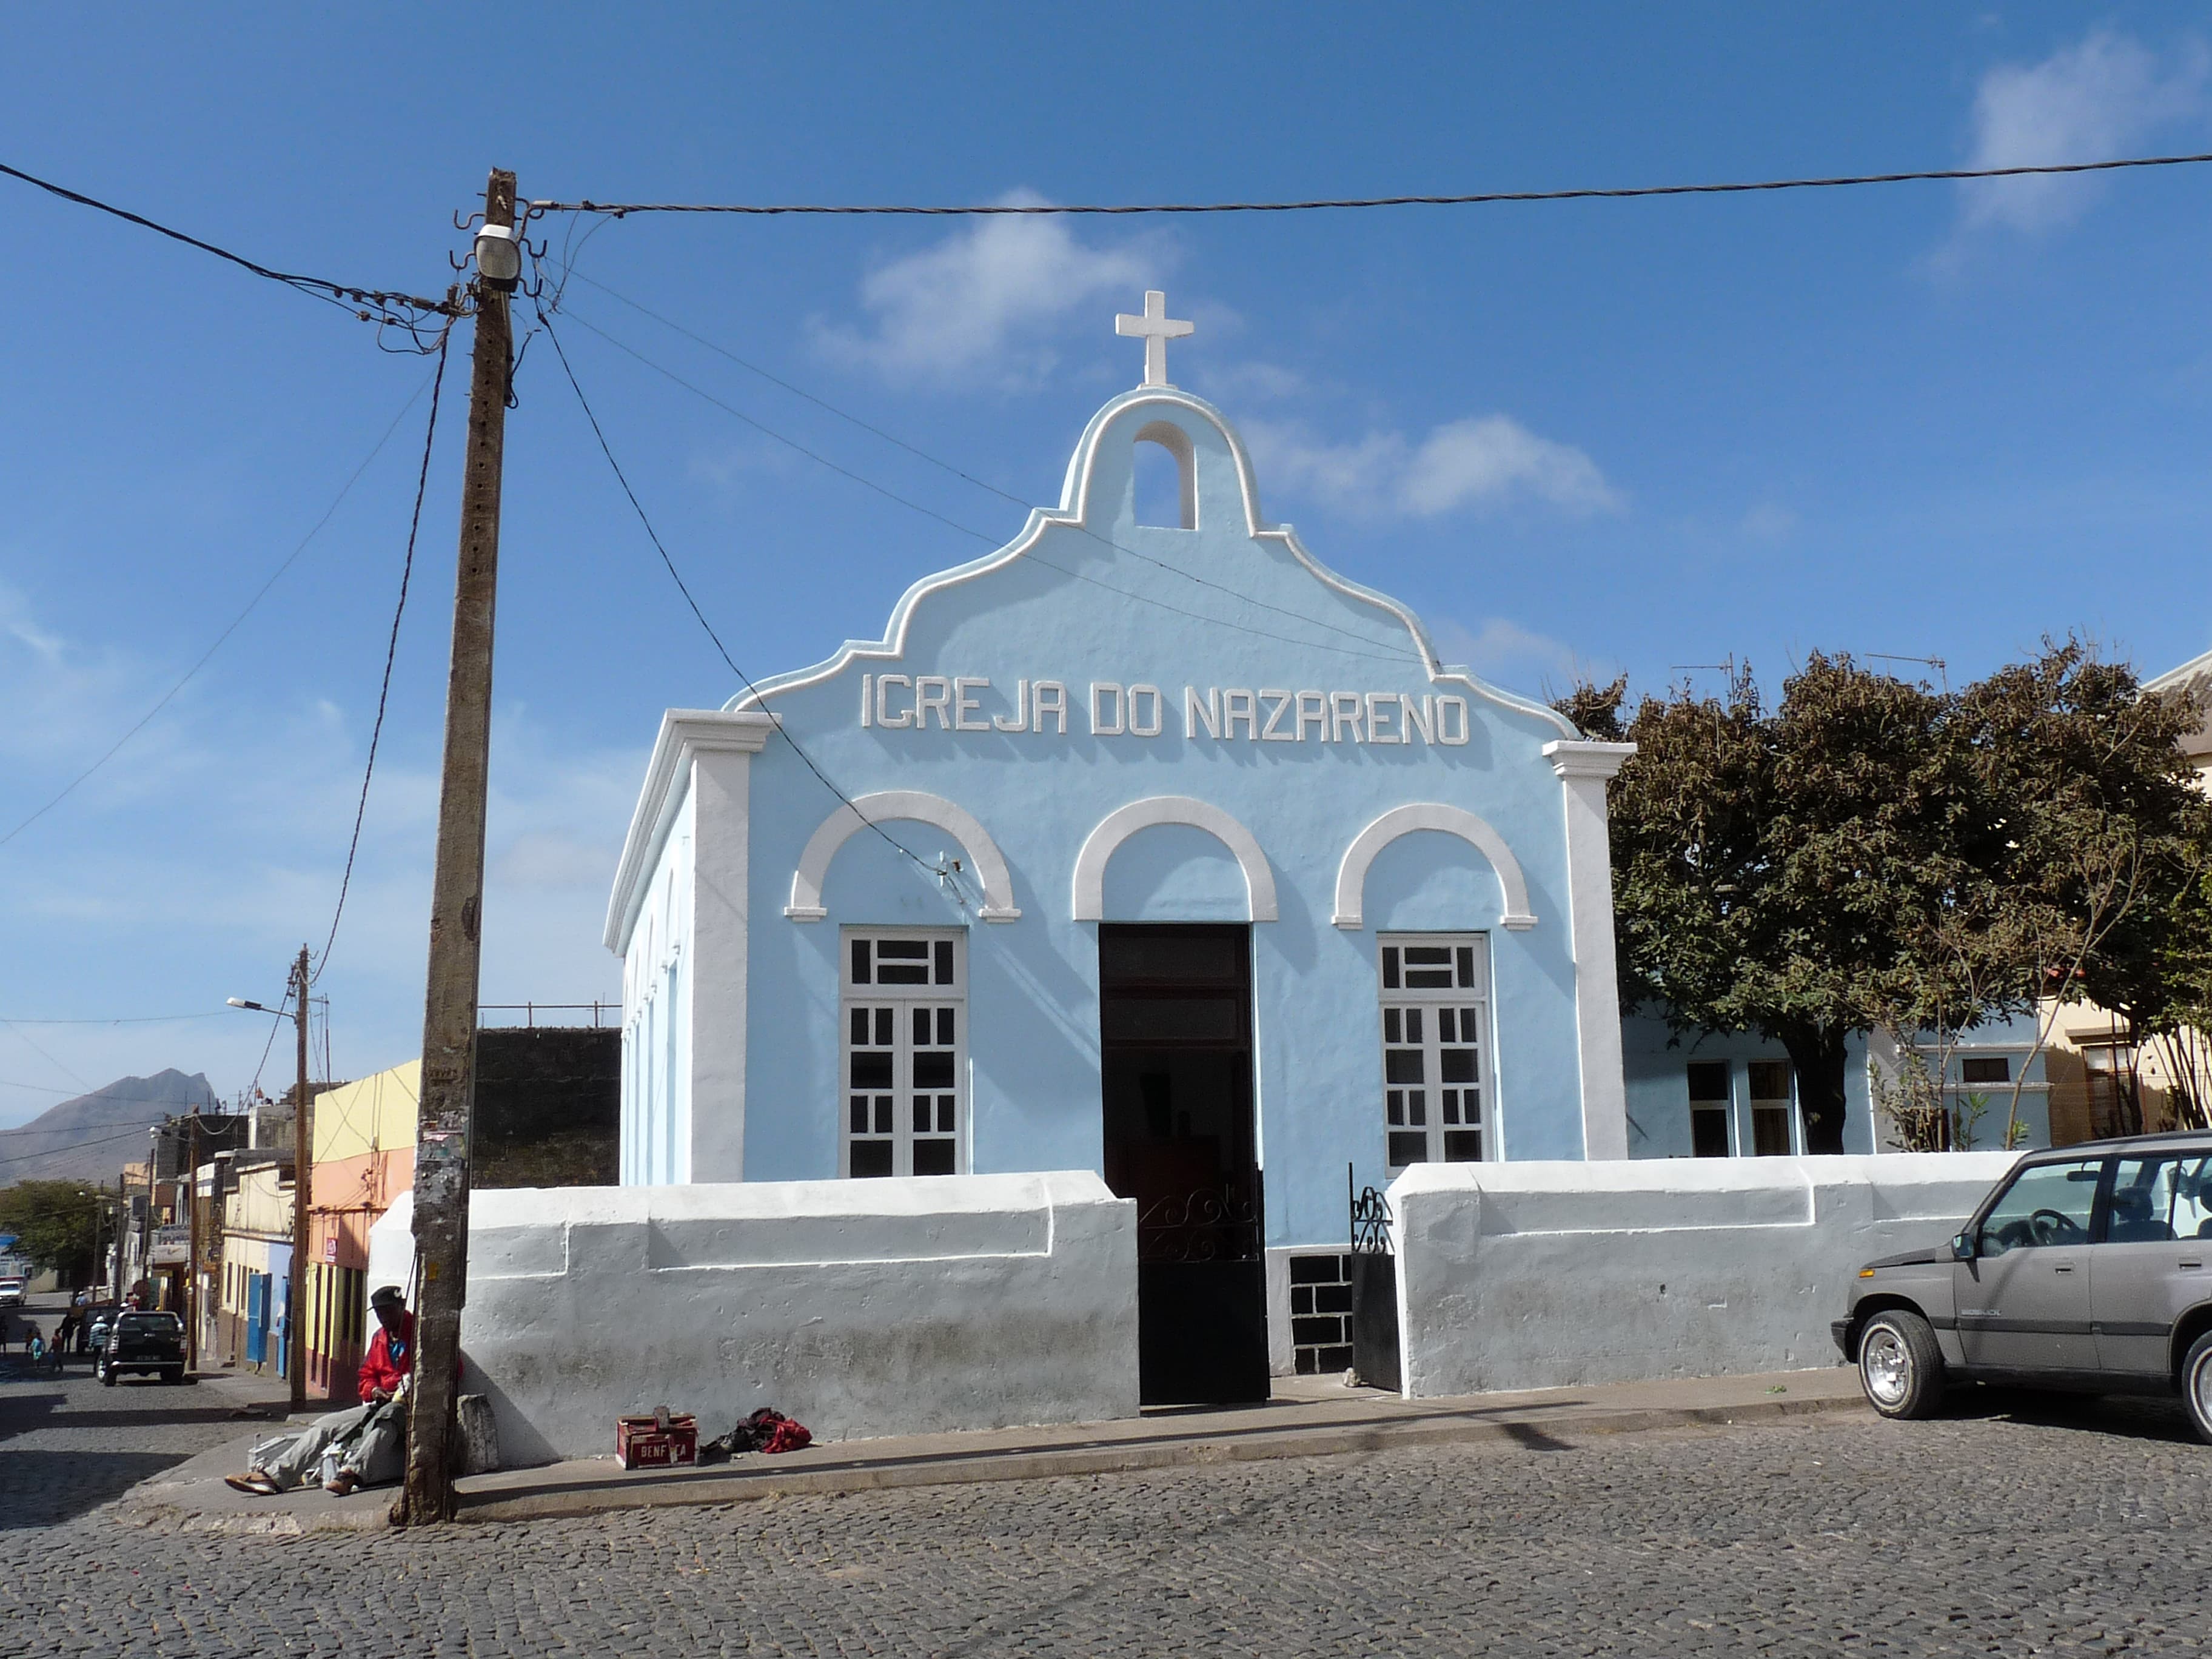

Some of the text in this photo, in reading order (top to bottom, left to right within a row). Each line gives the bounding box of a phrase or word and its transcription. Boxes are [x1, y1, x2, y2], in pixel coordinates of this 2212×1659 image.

[861, 673, 1469, 746] IGREJA DO NAZARENO
[641, 1444, 686, 1456] BENFCA
